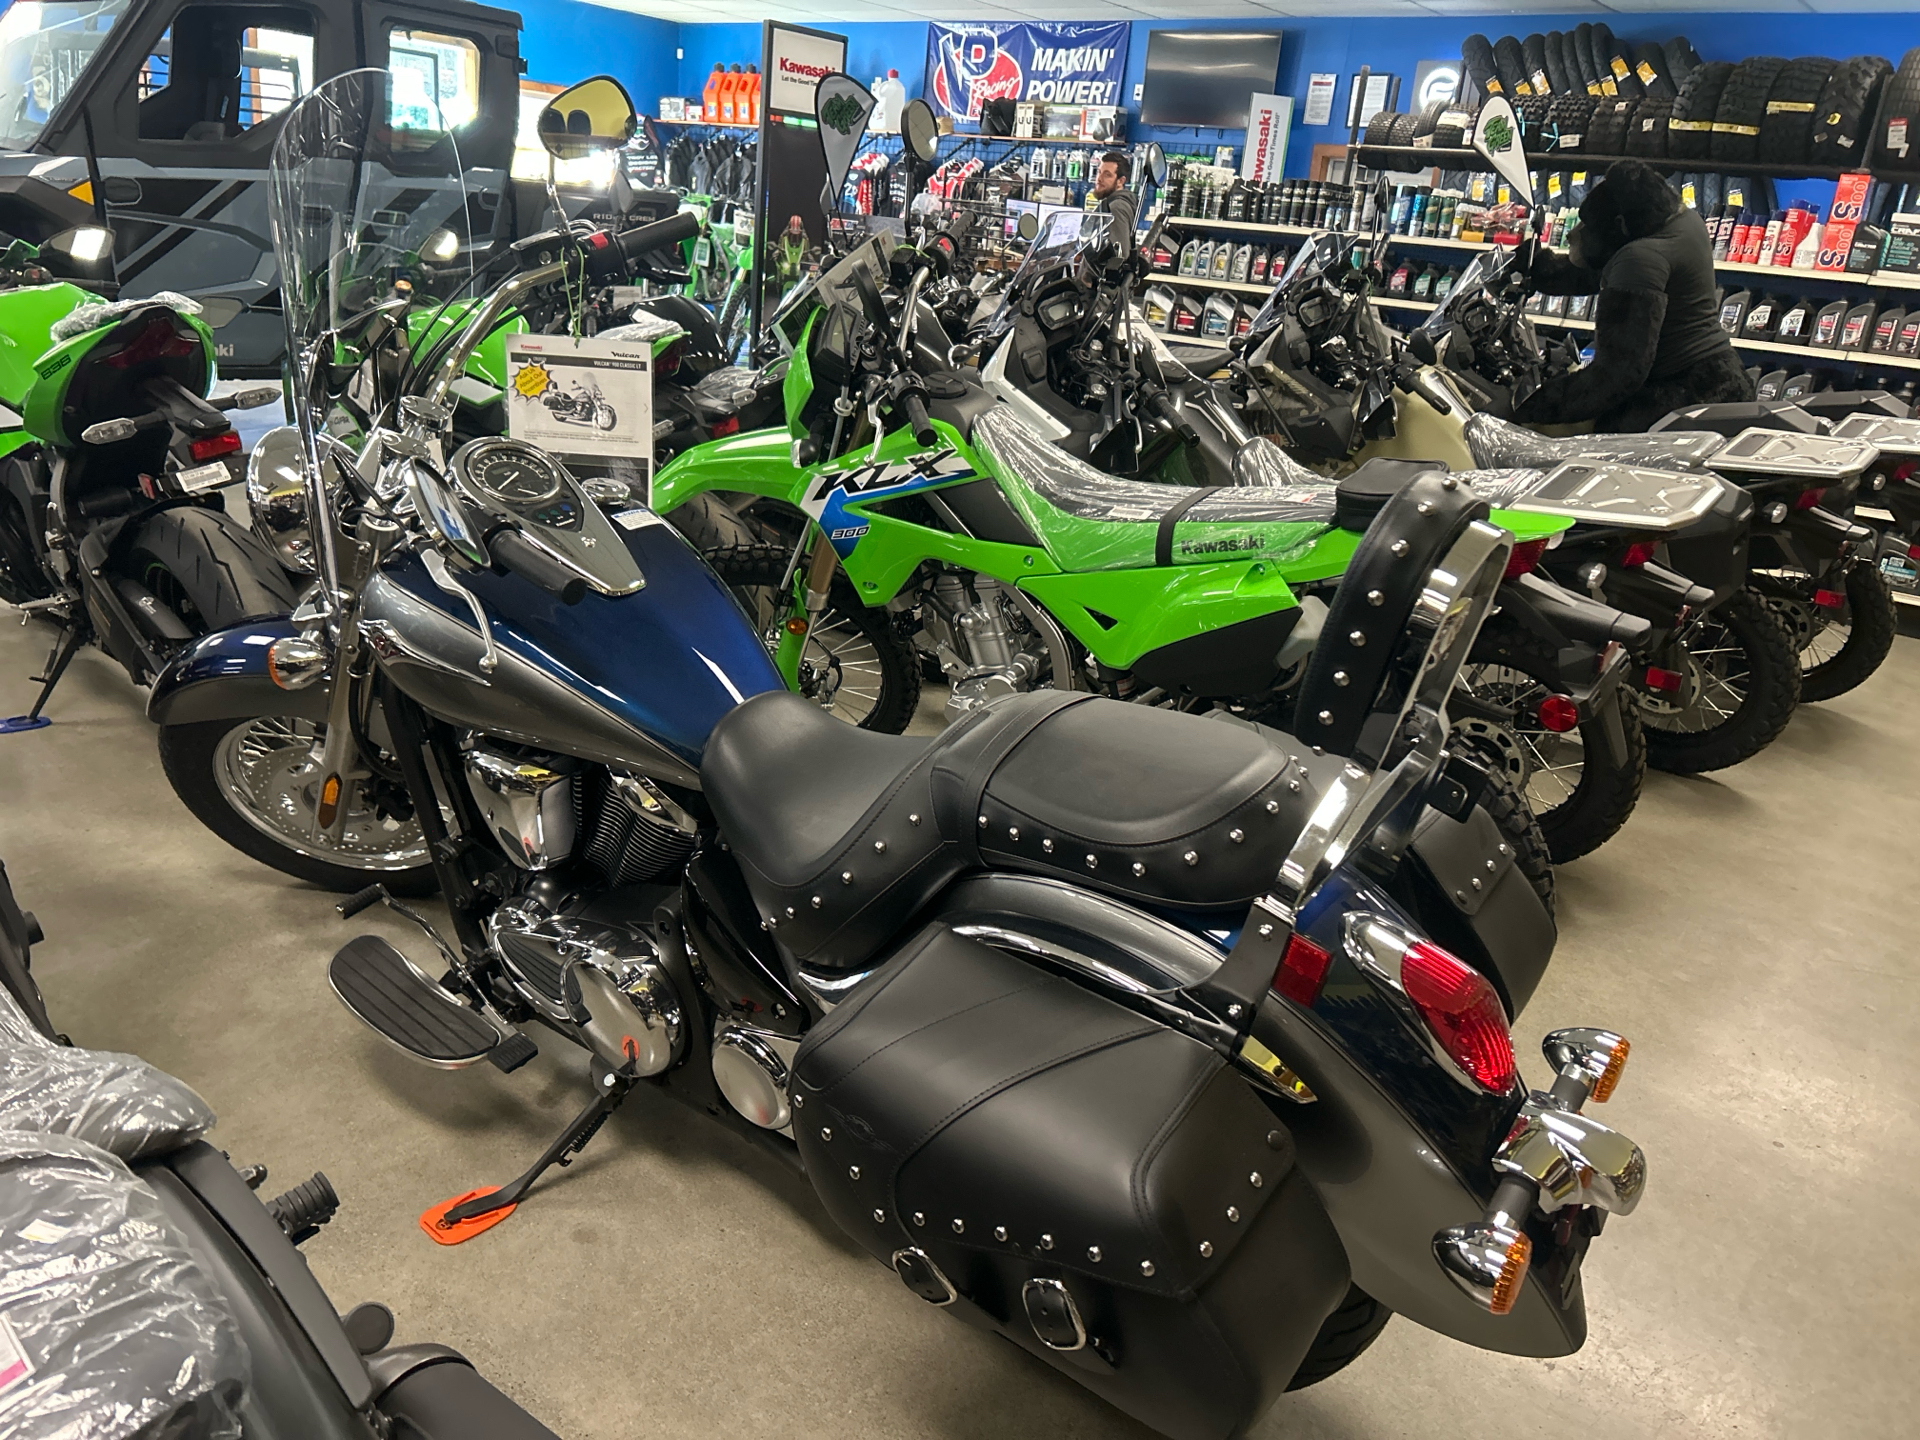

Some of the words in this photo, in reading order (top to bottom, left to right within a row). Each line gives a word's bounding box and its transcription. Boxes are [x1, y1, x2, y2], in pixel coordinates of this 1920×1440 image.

[780, 57, 836, 77] Kawasak
[1031, 47, 1115, 72] MAKIN'
[973, 75, 1018, 99] Racing
[1026, 79, 1116, 104] POWER!
[1253, 109, 1272, 187] awasaki
[1832, 180, 1867, 220] S100
[593, 213, 627, 221] RID
[1819, 228, 1853, 268] S100
[40, 354, 71, 380] 636
[611, 351, 640, 359] Vulcan
[812, 448, 958, 501] KLX
[831, 524, 871, 540] 300
[1181, 532, 1265, 555] Kawasaki
